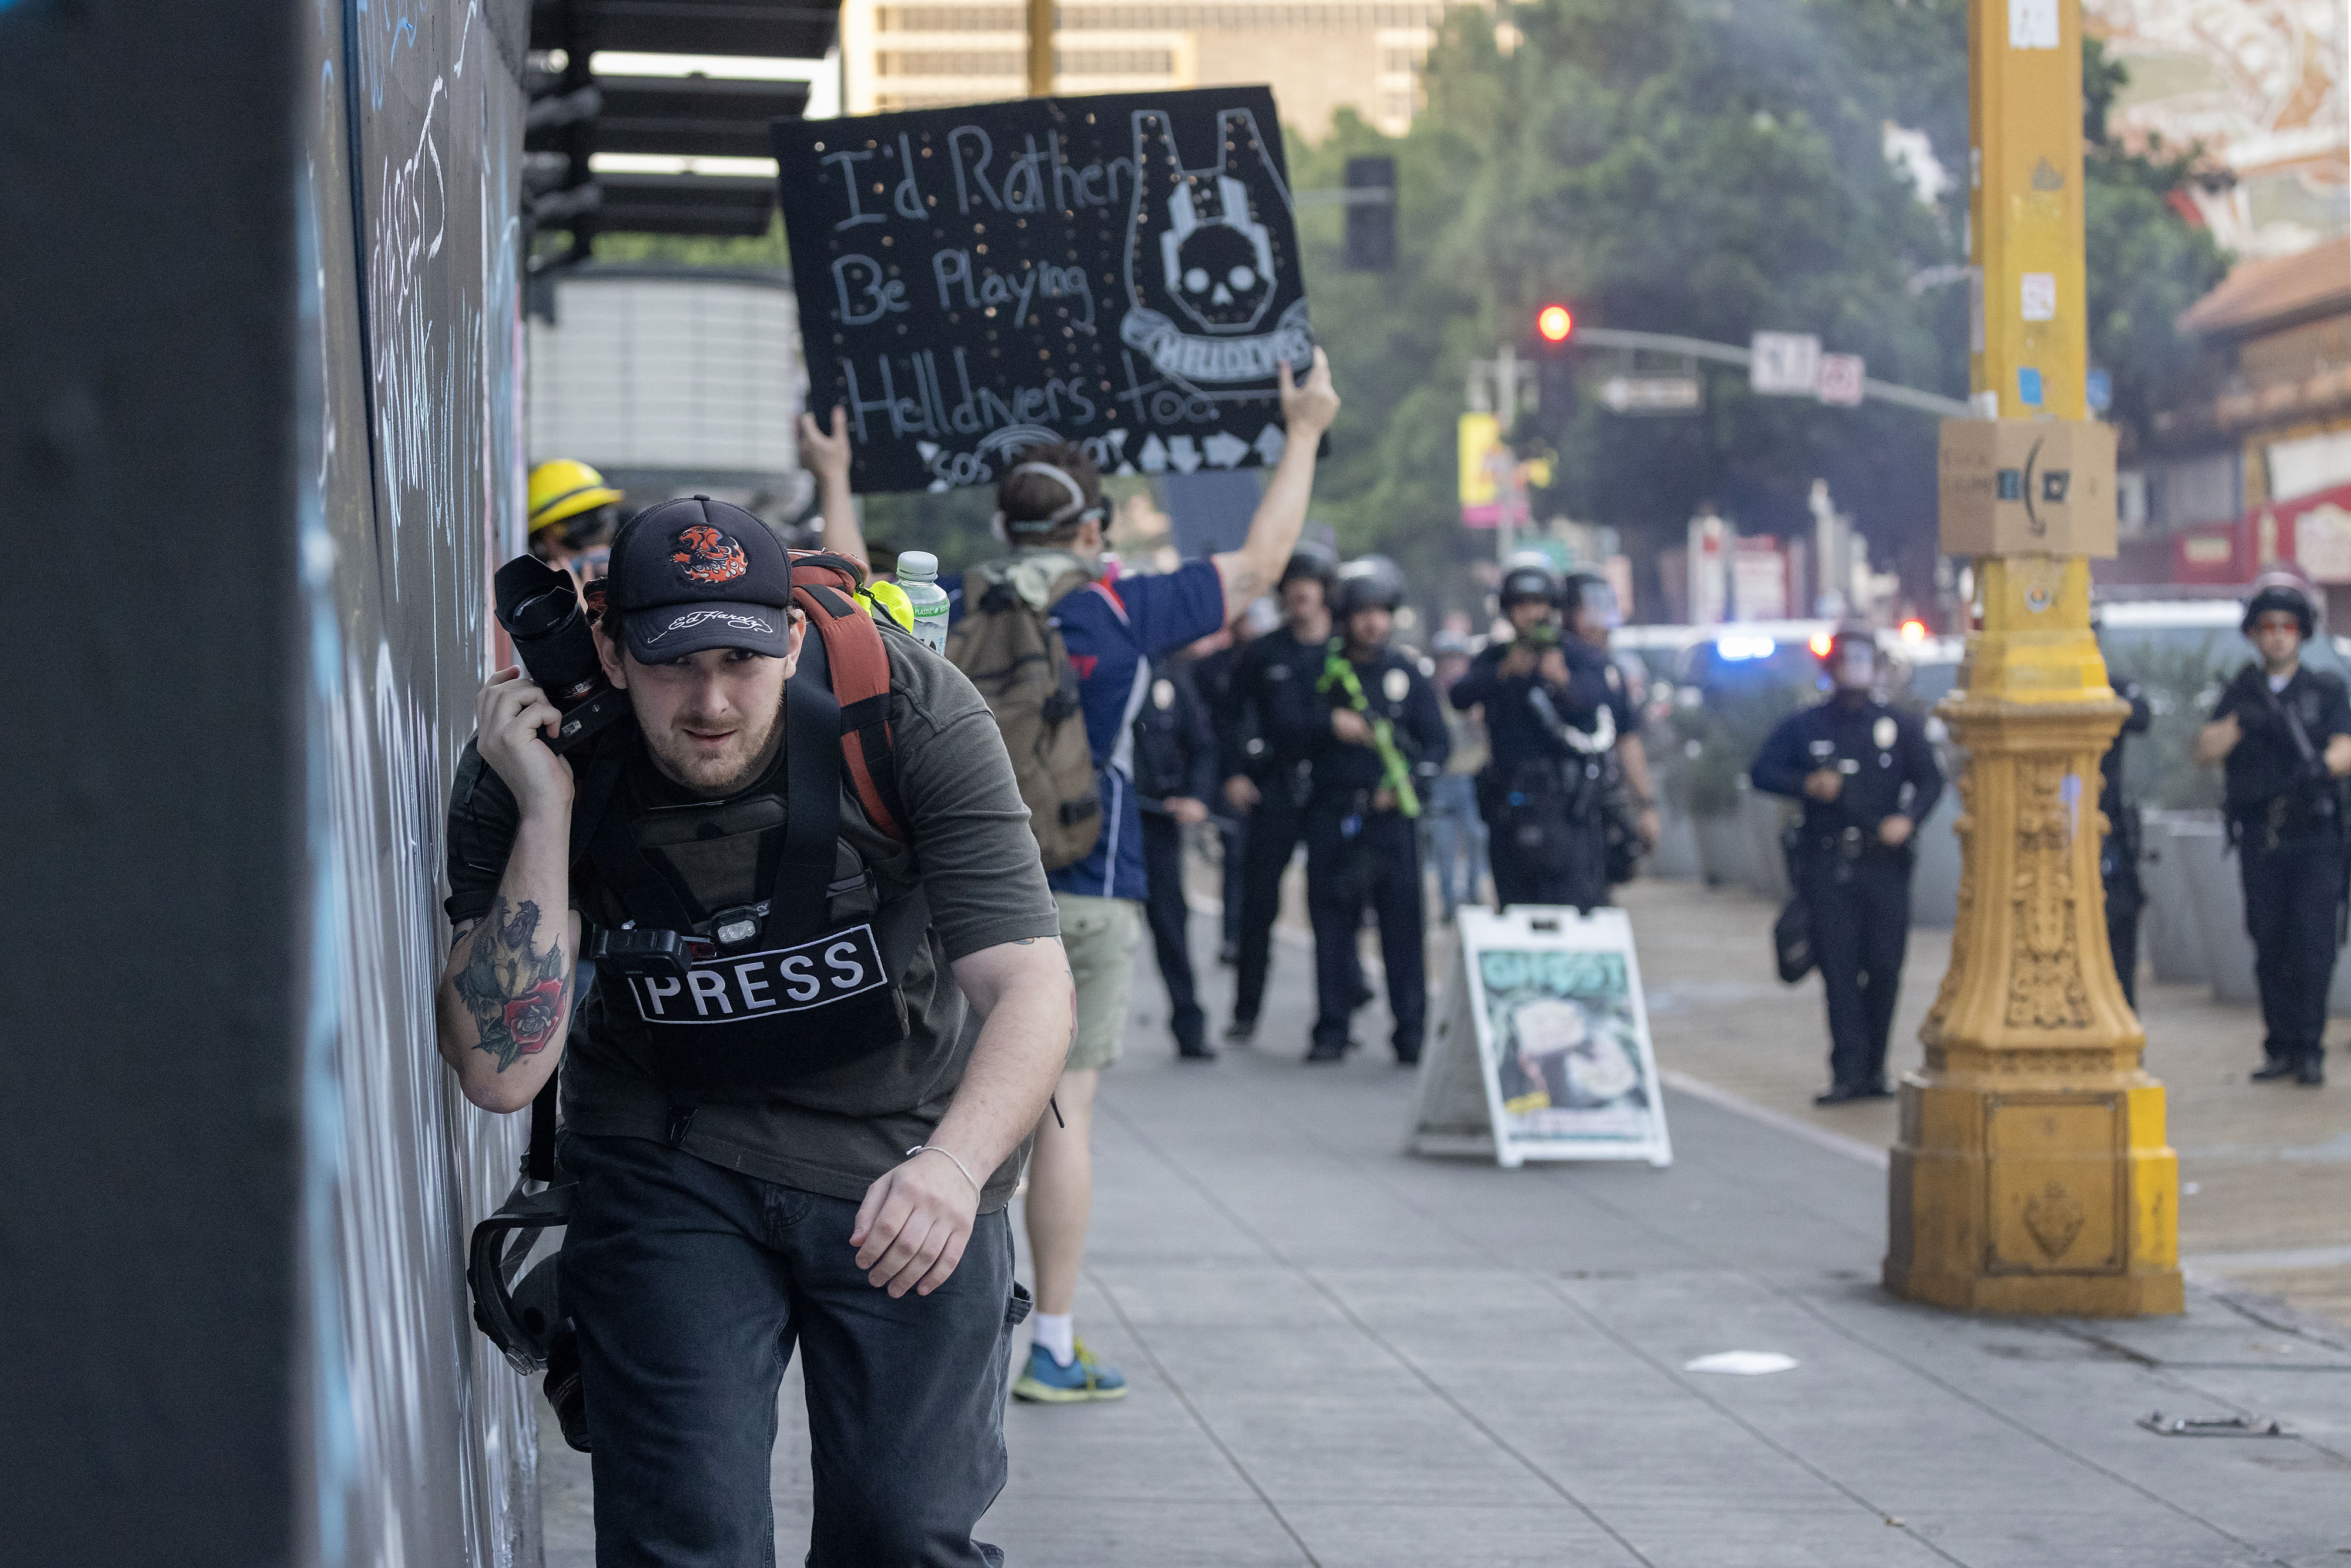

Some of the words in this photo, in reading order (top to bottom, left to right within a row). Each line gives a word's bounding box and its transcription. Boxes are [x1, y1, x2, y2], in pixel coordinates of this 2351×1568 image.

[823, 130, 929, 232] I'd
[947, 125, 1134, 215] Rather
[832, 253, 911, 326] Be
[932, 248, 1096, 334] Playing
[844, 348, 1097, 444] Helldivers
[645, 941, 865, 1016] PRESS
